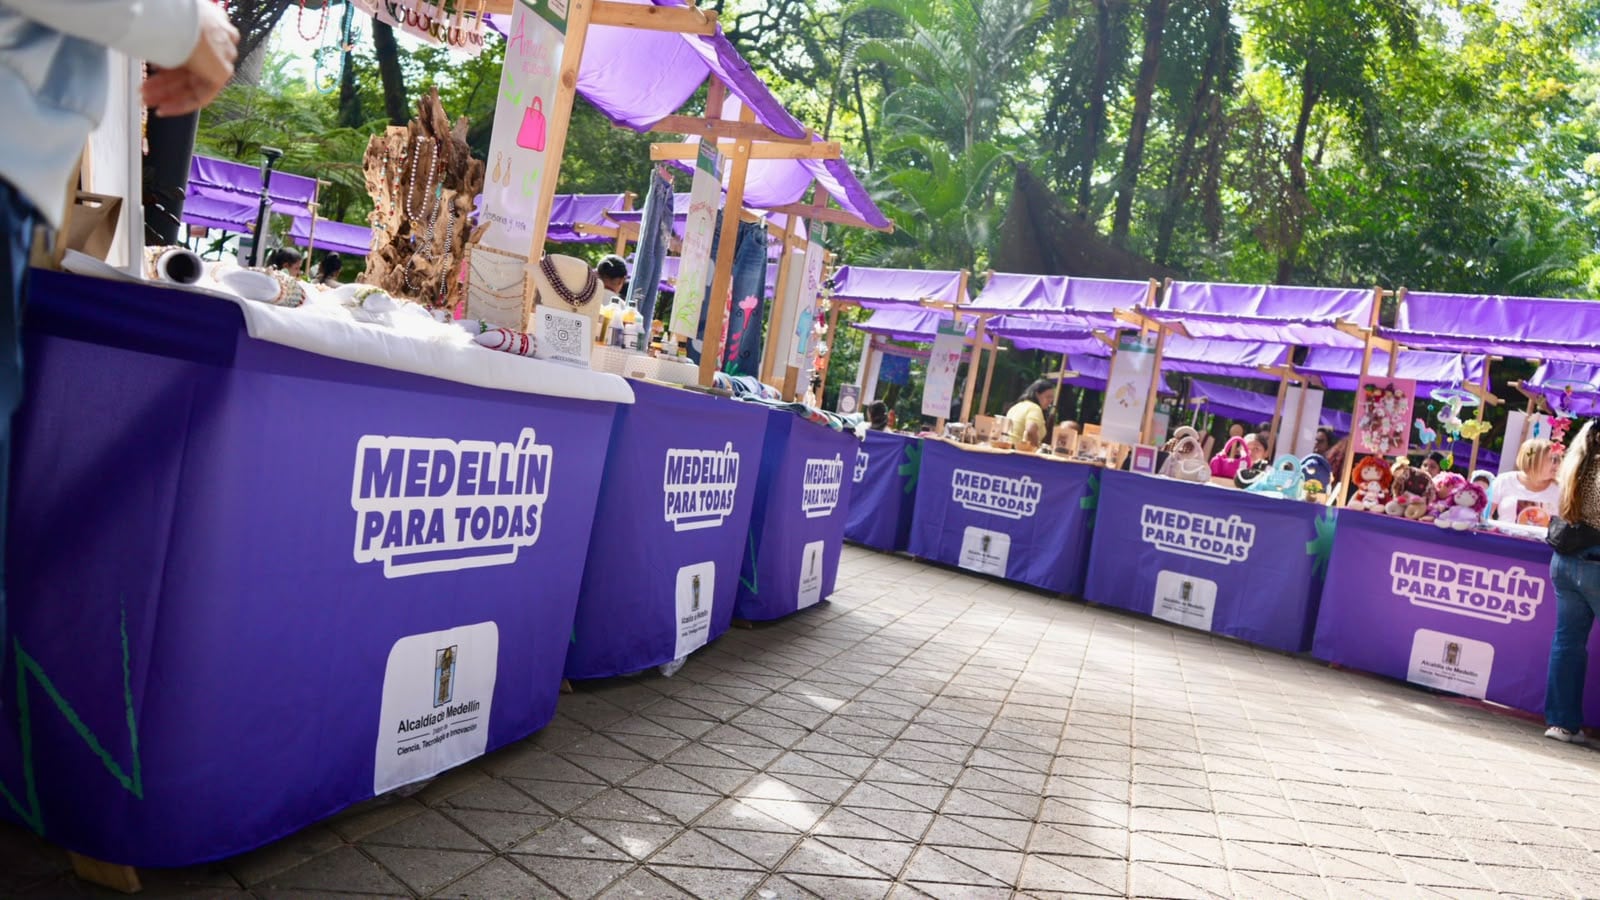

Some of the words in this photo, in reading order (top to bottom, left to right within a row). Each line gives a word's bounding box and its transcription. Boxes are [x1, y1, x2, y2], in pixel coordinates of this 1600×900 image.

[359, 437, 549, 499] MEDELLÍN
[666, 447, 738, 485] MEDELLÍN
[666, 491, 697, 515] PARA
[699, 489, 733, 512] TODAS
[954, 471, 1039, 500] MEDELLÍN
[955, 488, 987, 506] PARA
[990, 495, 1033, 513] TODAS
[361, 507, 445, 551] PARA
[454, 504, 539, 542] TODAS
[1144, 508, 1252, 543] MEDELLÍN
[1145, 527, 1186, 545] PARA
[1190, 535, 1245, 557] TODAS
[1394, 556, 1540, 600] MEDELLÍN
[1396, 578, 1451, 601] PARA
[1456, 589, 1531, 617] TODAS
[397, 713, 437, 734] Alcaldía
[446, 700, 480, 718] Medellín
